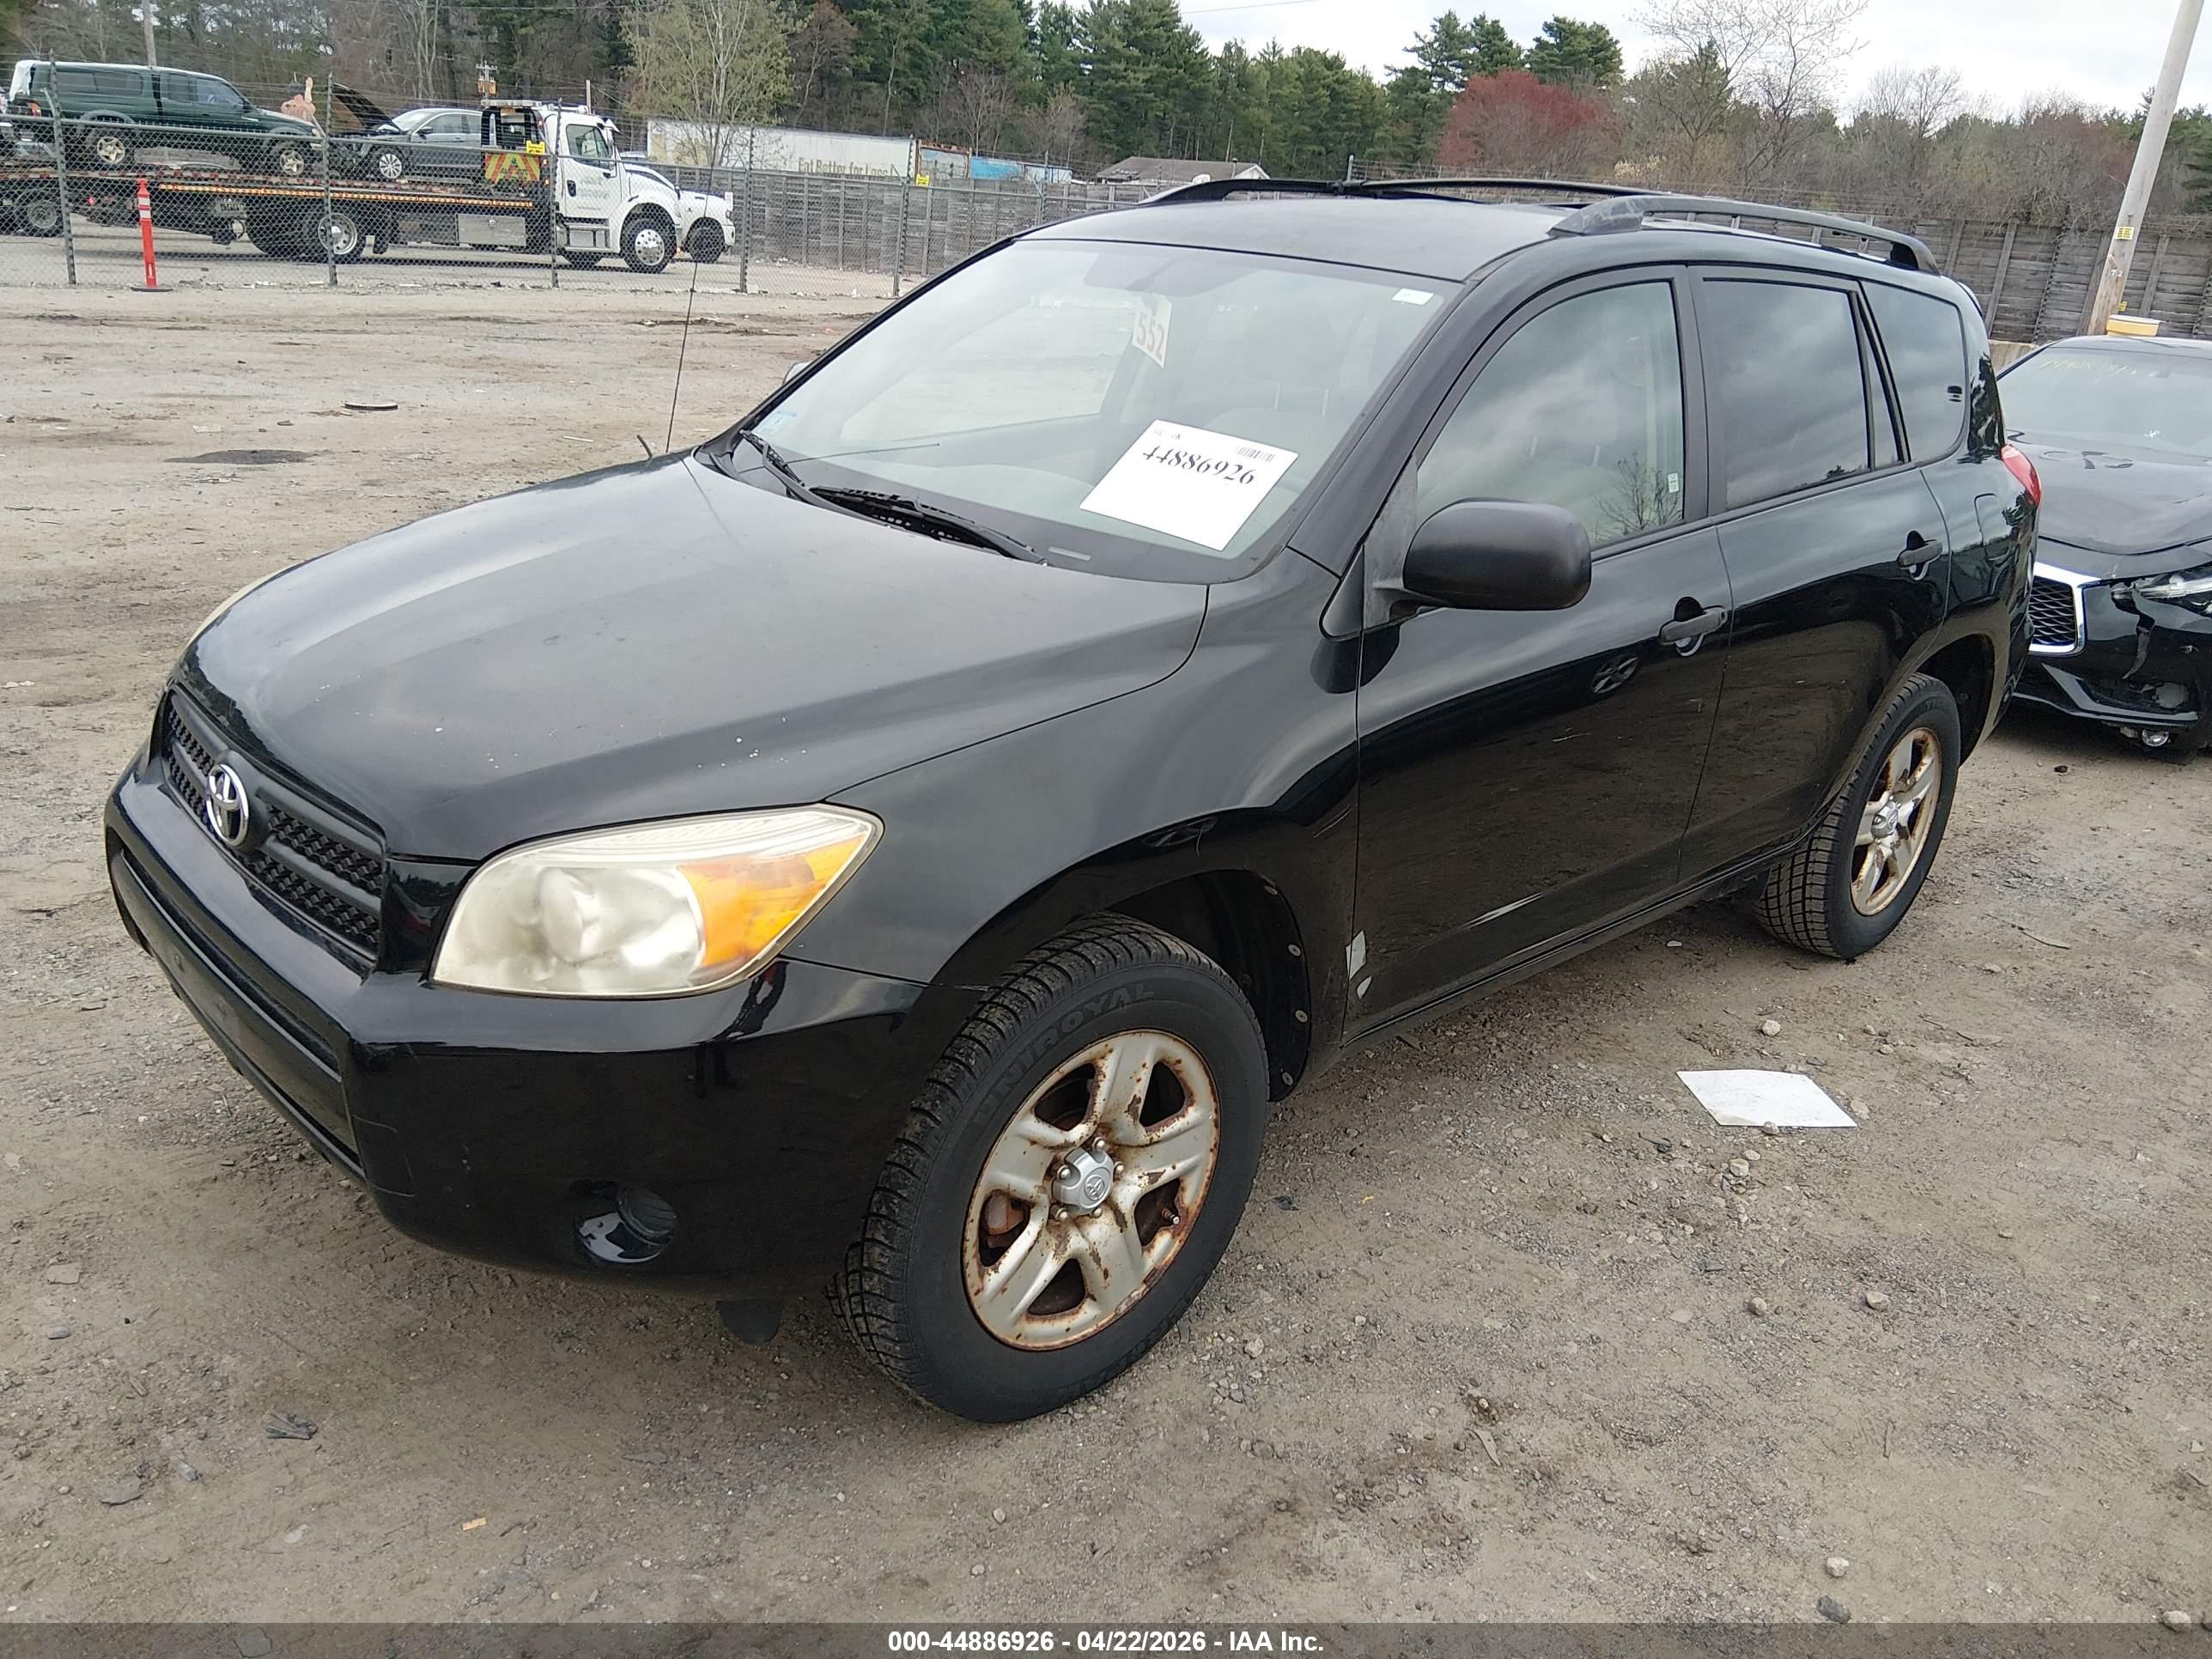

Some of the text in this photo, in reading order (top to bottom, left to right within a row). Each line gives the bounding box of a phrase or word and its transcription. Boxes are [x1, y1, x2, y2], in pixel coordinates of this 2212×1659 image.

[798, 157, 813, 173] Eat
[817, 159, 846, 174] Better
[849, 161, 864, 175] for
[1142, 446, 1256, 484] 44886926
